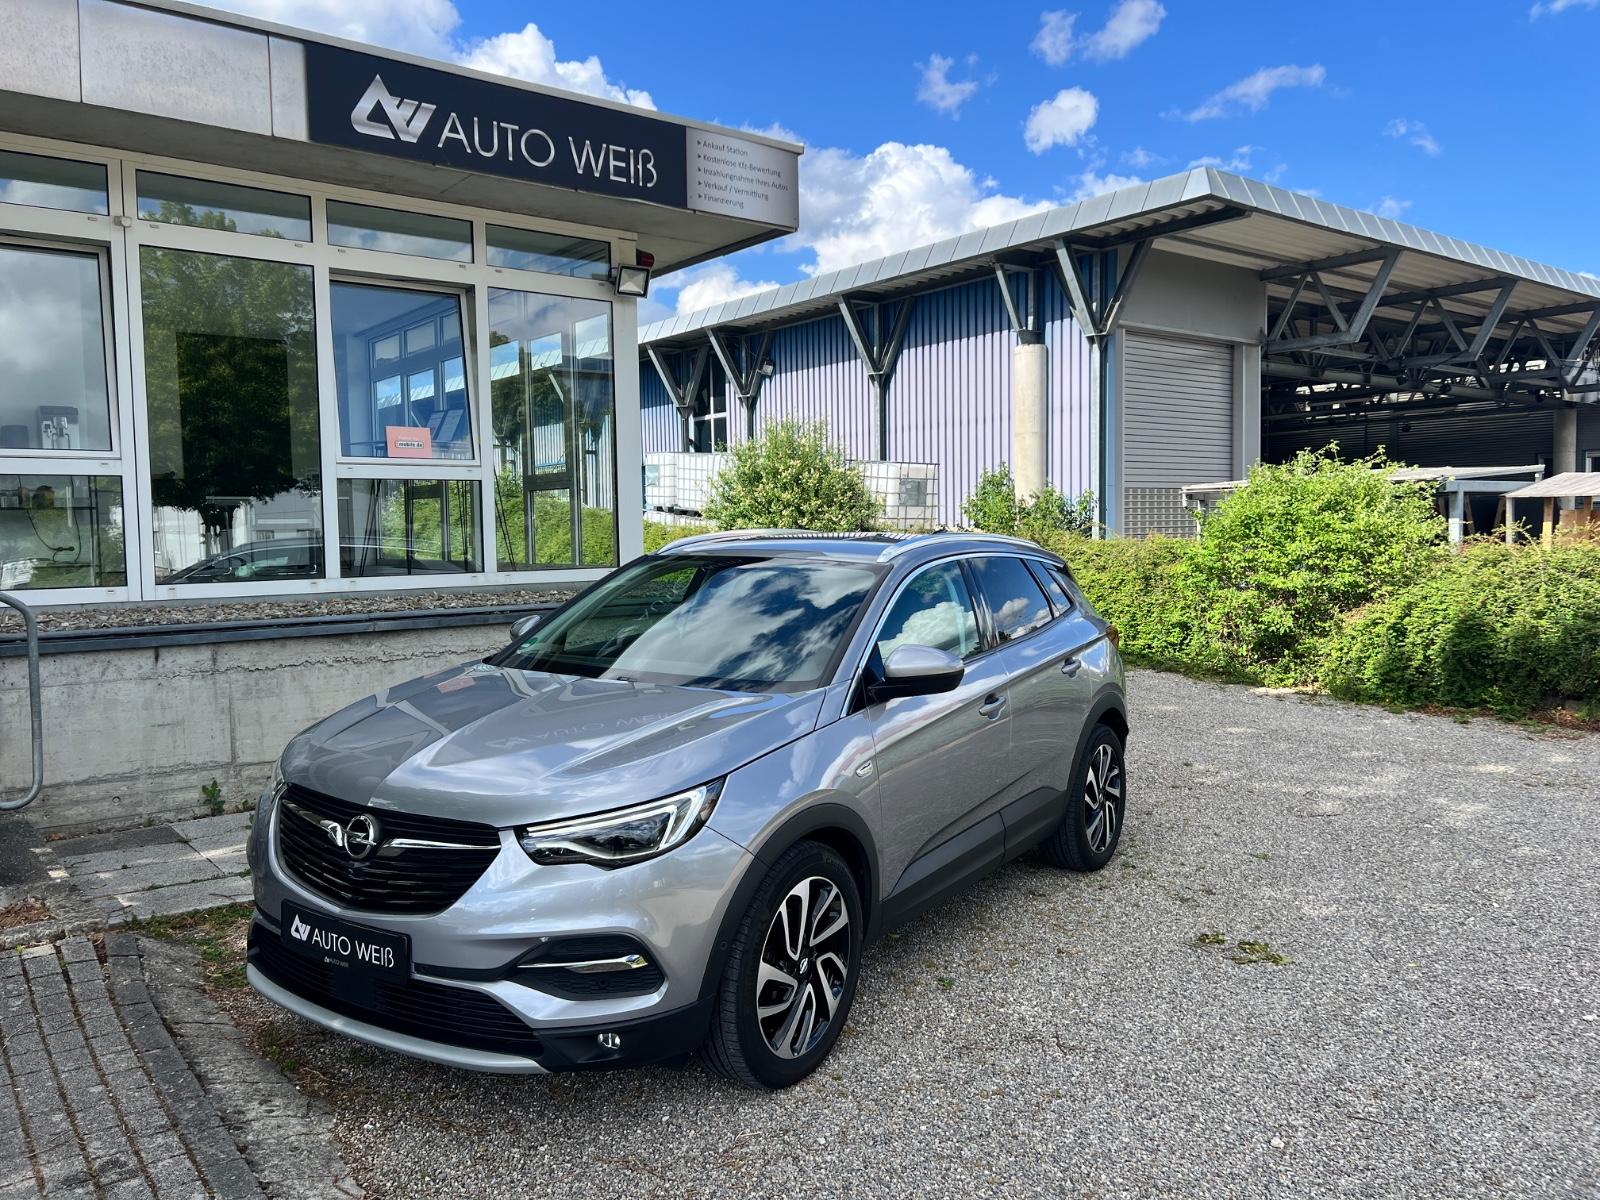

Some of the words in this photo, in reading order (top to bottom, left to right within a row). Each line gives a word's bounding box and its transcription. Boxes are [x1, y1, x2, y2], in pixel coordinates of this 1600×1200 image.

[437, 112, 555, 167] AUTO
[568, 136, 657, 188] WEIß
[703, 141, 725, 151] Ankauf
[727, 145, 748, 156] Station
[703, 154, 737, 167] Kostenlose
[704, 181, 728, 191] Verkauf
[734, 186, 768, 201] Vermittlung
[771, 181, 788, 191] Autos
[704, 194, 744, 208] Finanzierung
[312, 927, 351, 955] AUTO
[355, 940, 394, 968] WEIß
